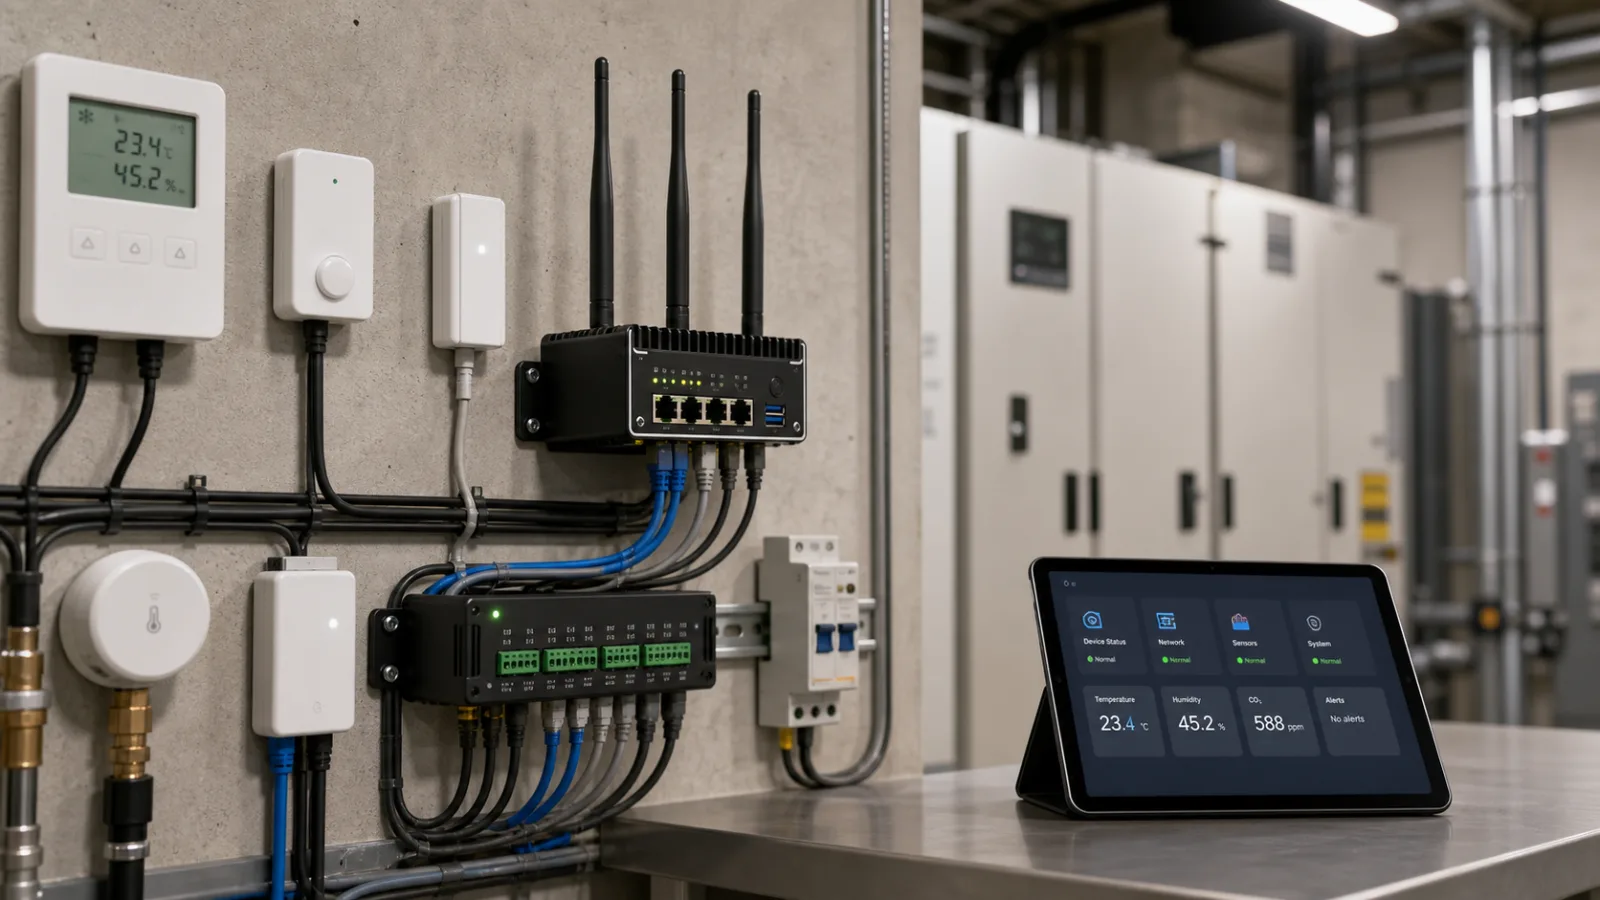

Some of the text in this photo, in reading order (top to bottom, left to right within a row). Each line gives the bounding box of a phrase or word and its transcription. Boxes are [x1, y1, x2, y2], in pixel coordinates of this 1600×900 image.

[114, 128, 161, 157] 23.4
[114, 162, 161, 190] 45.2
[1083, 637, 1127, 646] Device Status
[1158, 638, 1185, 646] Network
[1232, 639, 1258, 647] Sensors
[1307, 640, 1332, 649] System
[1094, 695, 1135, 704] Temperature
[1172, 696, 1202, 705] Humidity
[1325, 696, 1345, 704] Alerts
[1099, 715, 1135, 731] 23.4
[1178, 715, 1226, 731] 45.2 %
[1254, 715, 1305, 732] 588 ppm
[1330, 715, 1365, 723] No alerts
